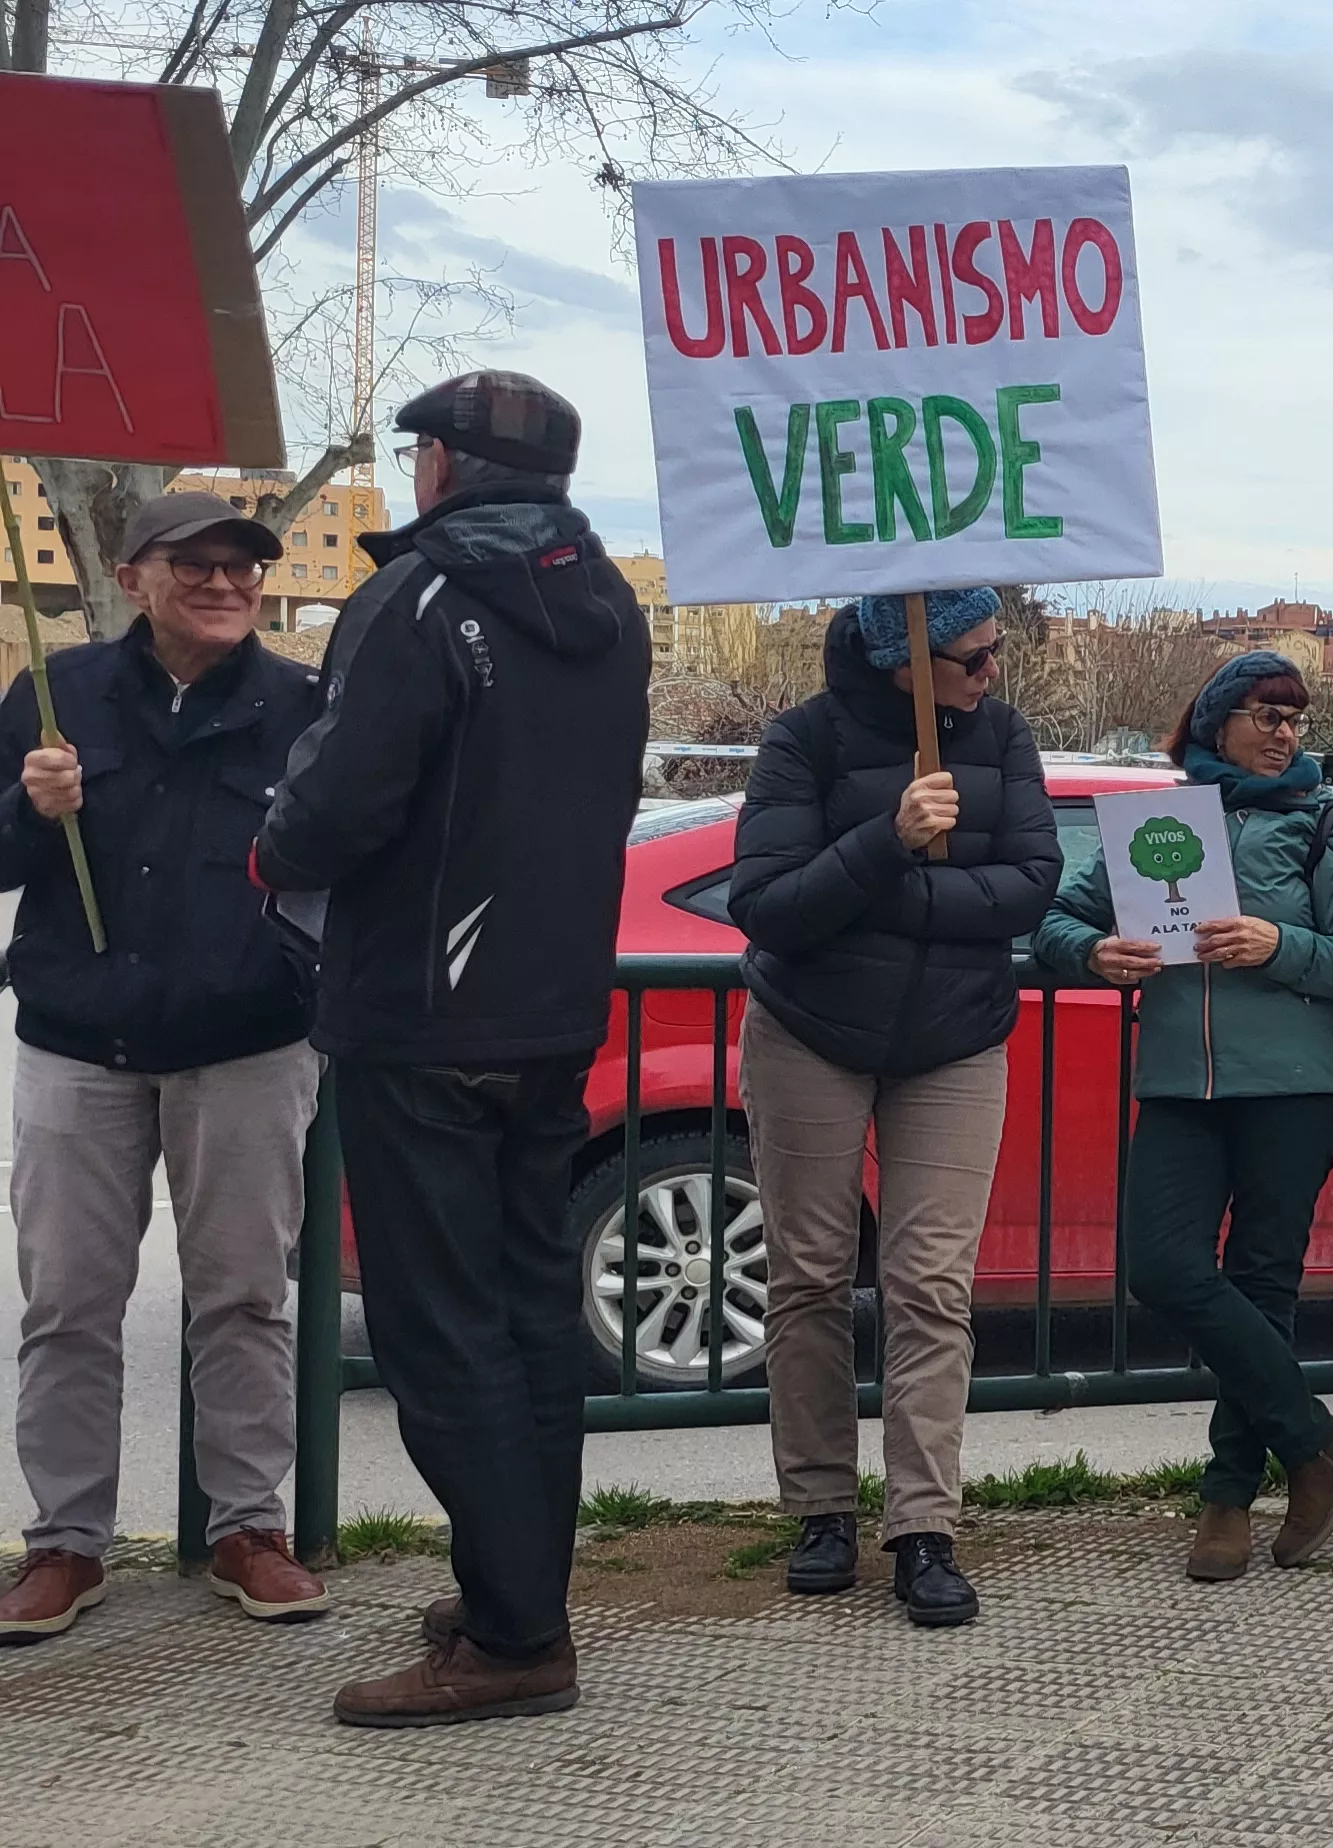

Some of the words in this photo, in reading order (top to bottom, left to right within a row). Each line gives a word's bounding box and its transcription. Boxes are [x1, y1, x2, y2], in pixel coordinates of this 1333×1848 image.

[657, 217, 1122, 358] URBANISMO
[734, 382, 1064, 548] VERDE
[1144, 830, 1186, 845] VIVOS
[1170, 906, 1190, 916] NO
[1151, 925, 1161, 934] A
[1163, 924, 1180, 933] LA
